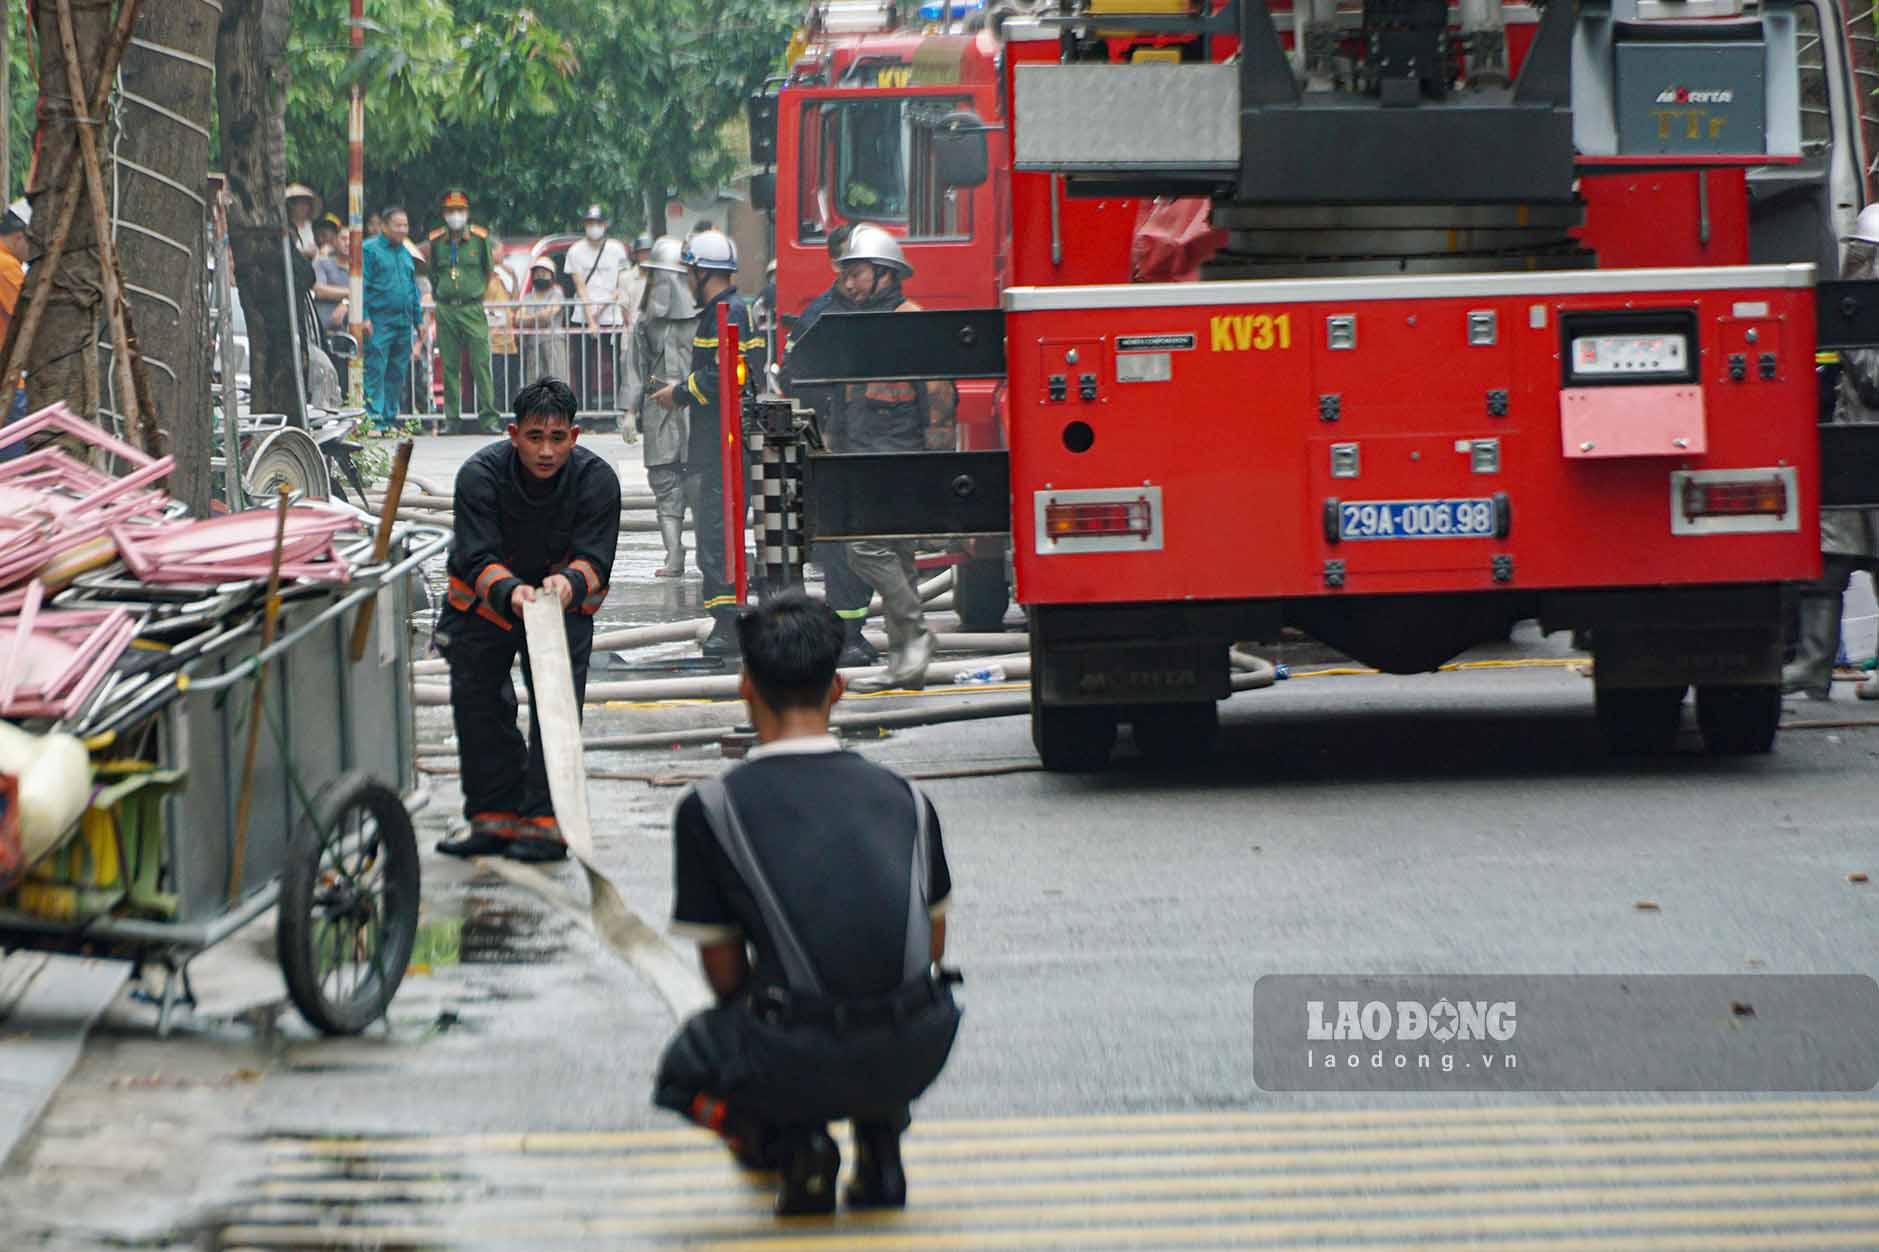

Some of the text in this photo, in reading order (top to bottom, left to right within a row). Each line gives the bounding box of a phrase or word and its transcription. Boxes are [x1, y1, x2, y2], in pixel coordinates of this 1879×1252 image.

[1655, 85, 1733, 104] MORITA
[1210, 313, 1291, 352] KV31
[1343, 503, 1491, 536] 29A-006.98
